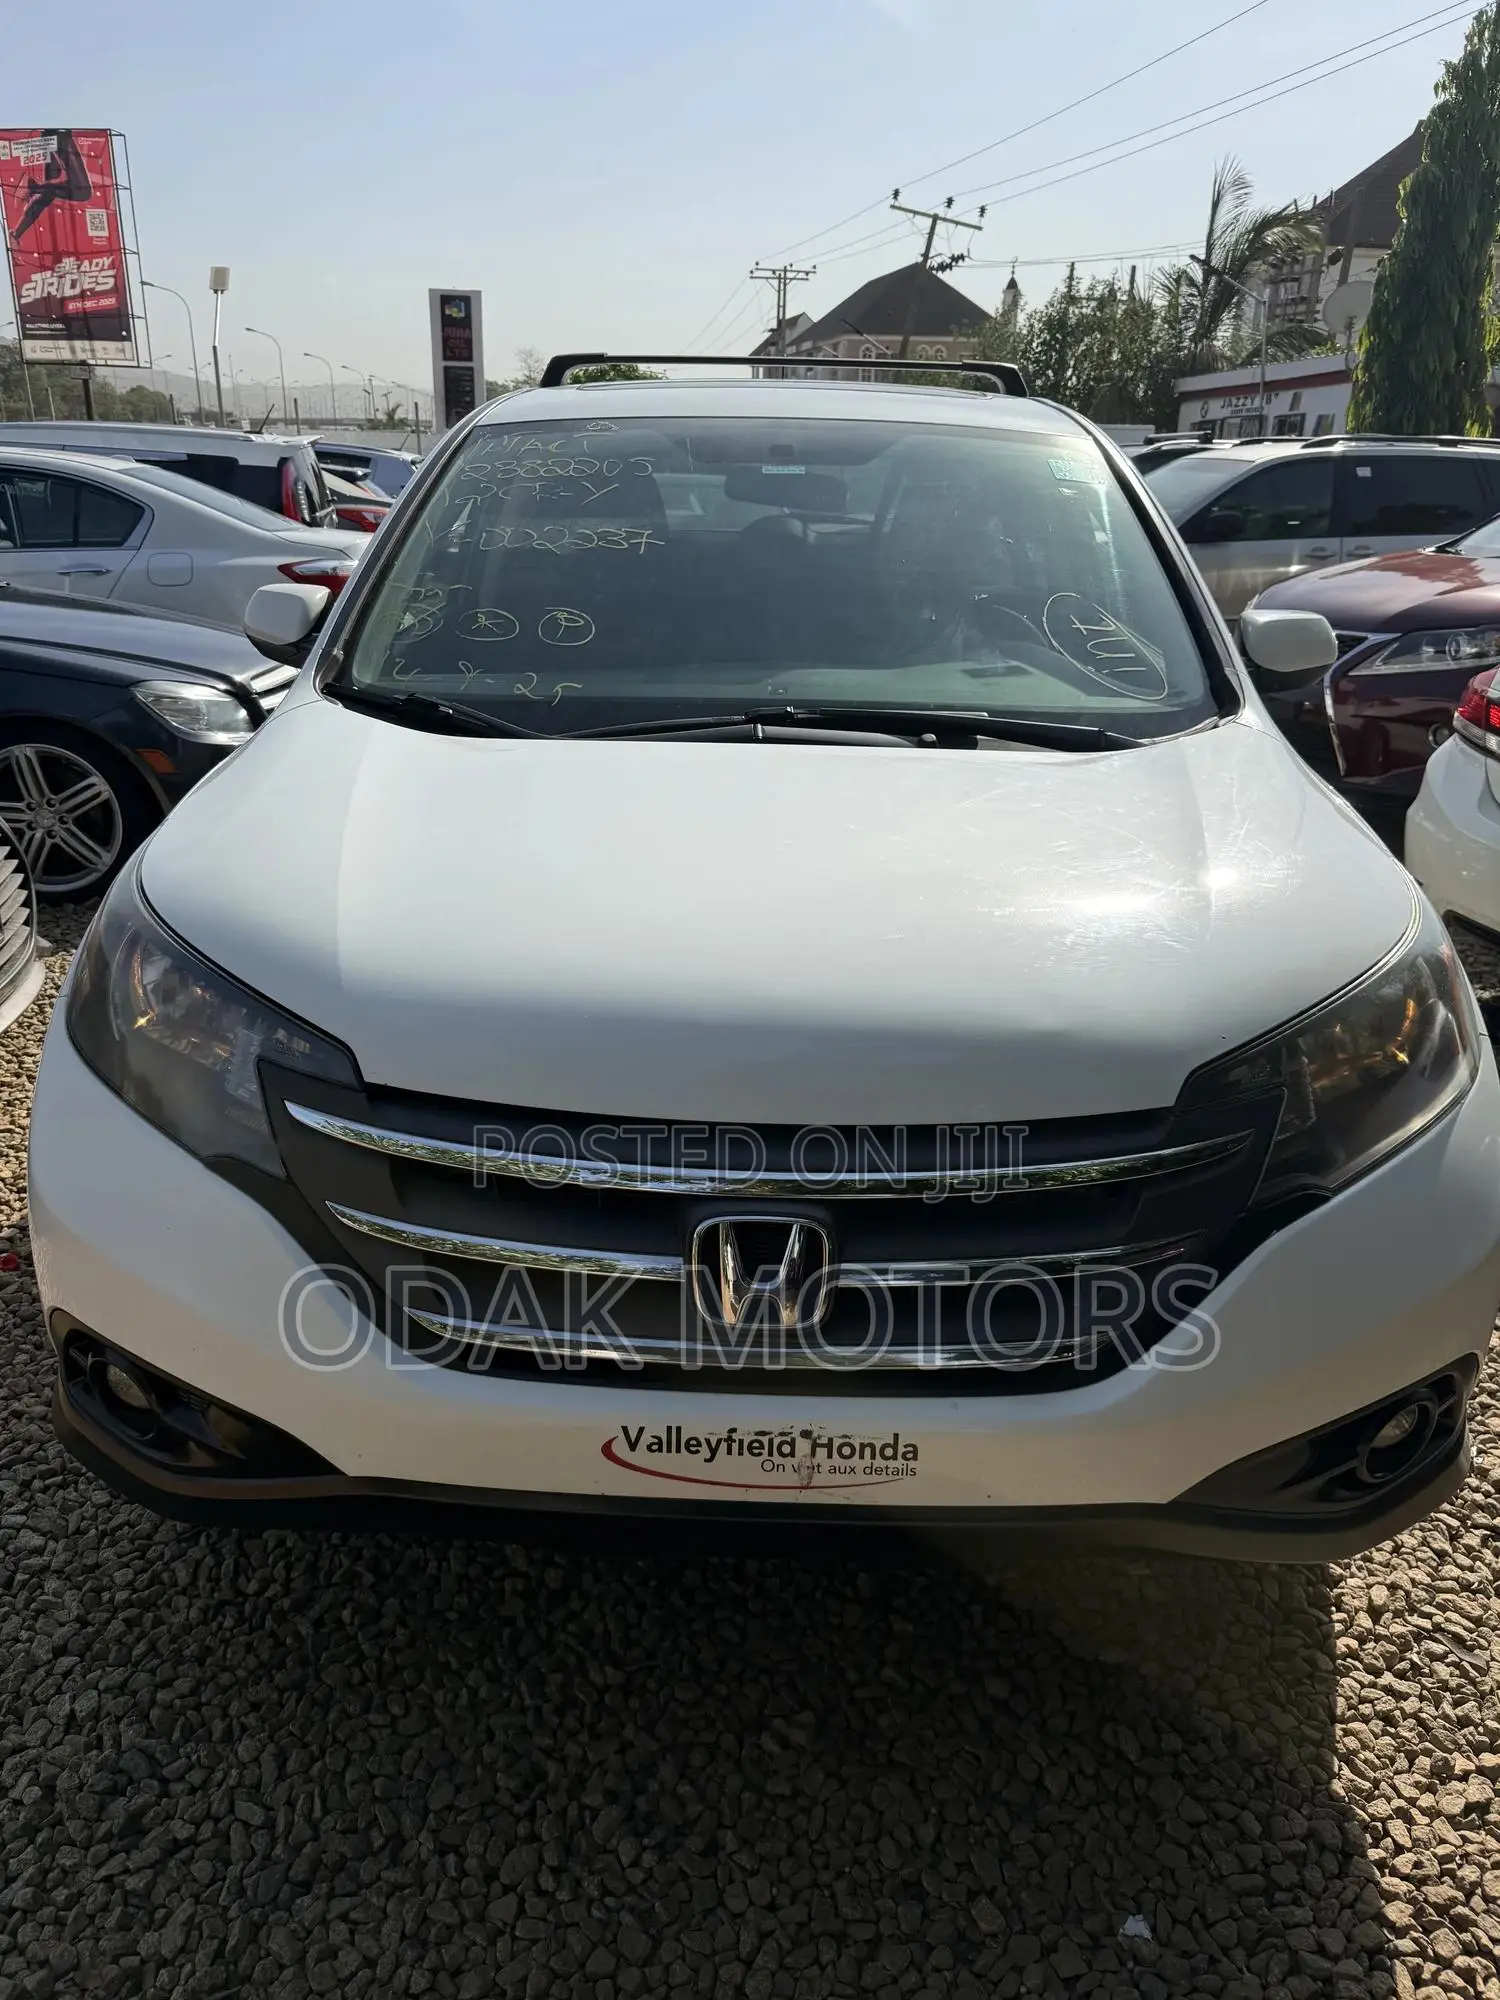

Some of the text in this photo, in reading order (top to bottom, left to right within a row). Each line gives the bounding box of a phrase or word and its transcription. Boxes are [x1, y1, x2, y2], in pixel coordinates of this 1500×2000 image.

[23, 152, 48, 165] 2025
[54, 256, 115, 276] STEADY
[20, 270, 117, 304] STRIDES
[1221, 395, 1258, 409] JAZZY
[621, 1425, 919, 1463] Valleyfield Honda
[760, 1459, 786, 1473] On
[828, 1465, 857, 1475] aux
[862, 1462, 917, 1477] details
